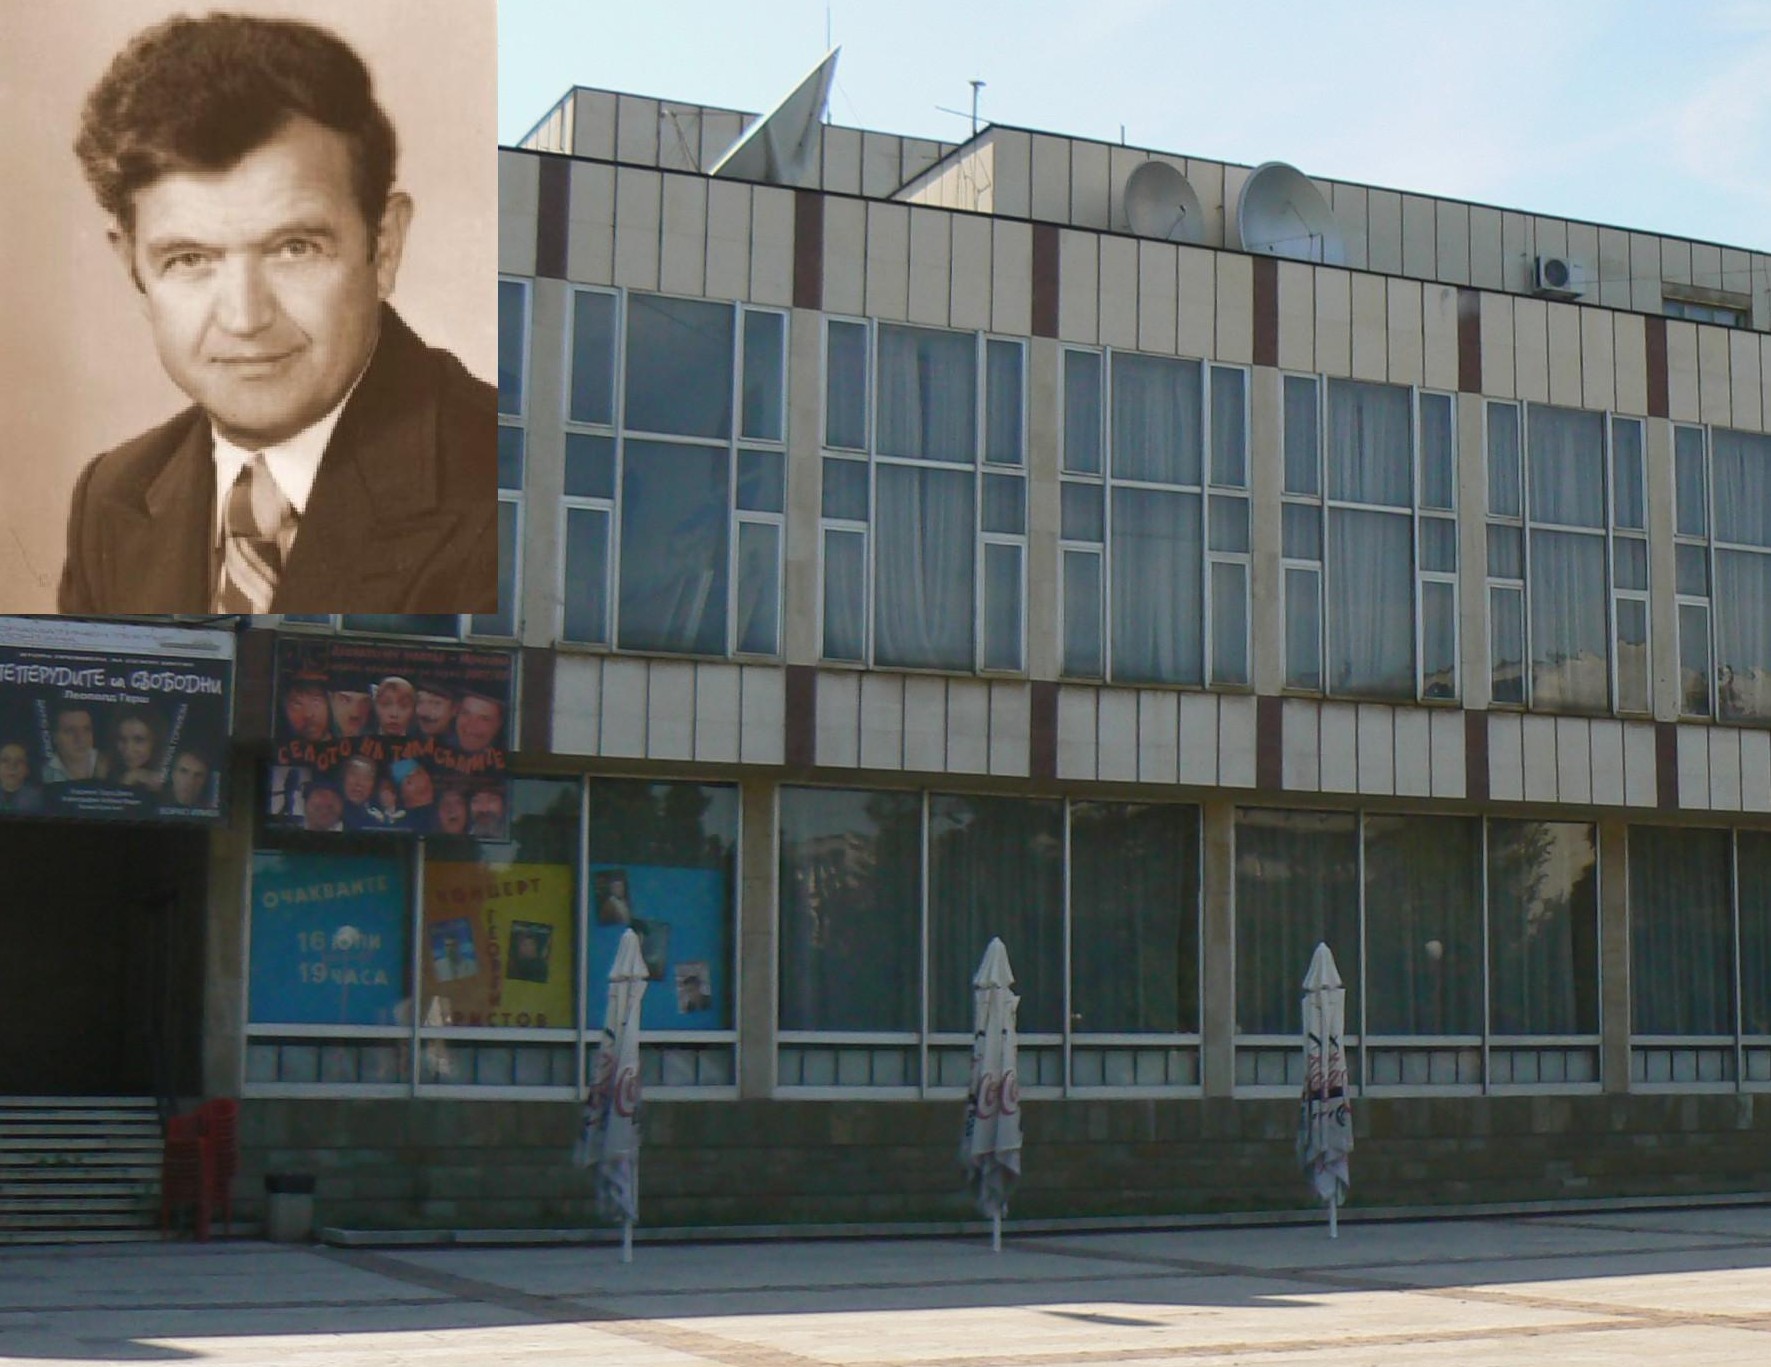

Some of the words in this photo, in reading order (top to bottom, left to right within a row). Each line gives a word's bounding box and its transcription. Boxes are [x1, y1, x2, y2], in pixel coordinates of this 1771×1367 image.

[278, 738, 352, 772] СЕЛОТО
[360, 736, 385, 760] НА
[436, 877, 541, 903] КОНЦЕРТ
[297, 930, 326, 952] 16
[299, 961, 328, 984] 19
[453, 1010, 547, 1028] РИСТОВ
